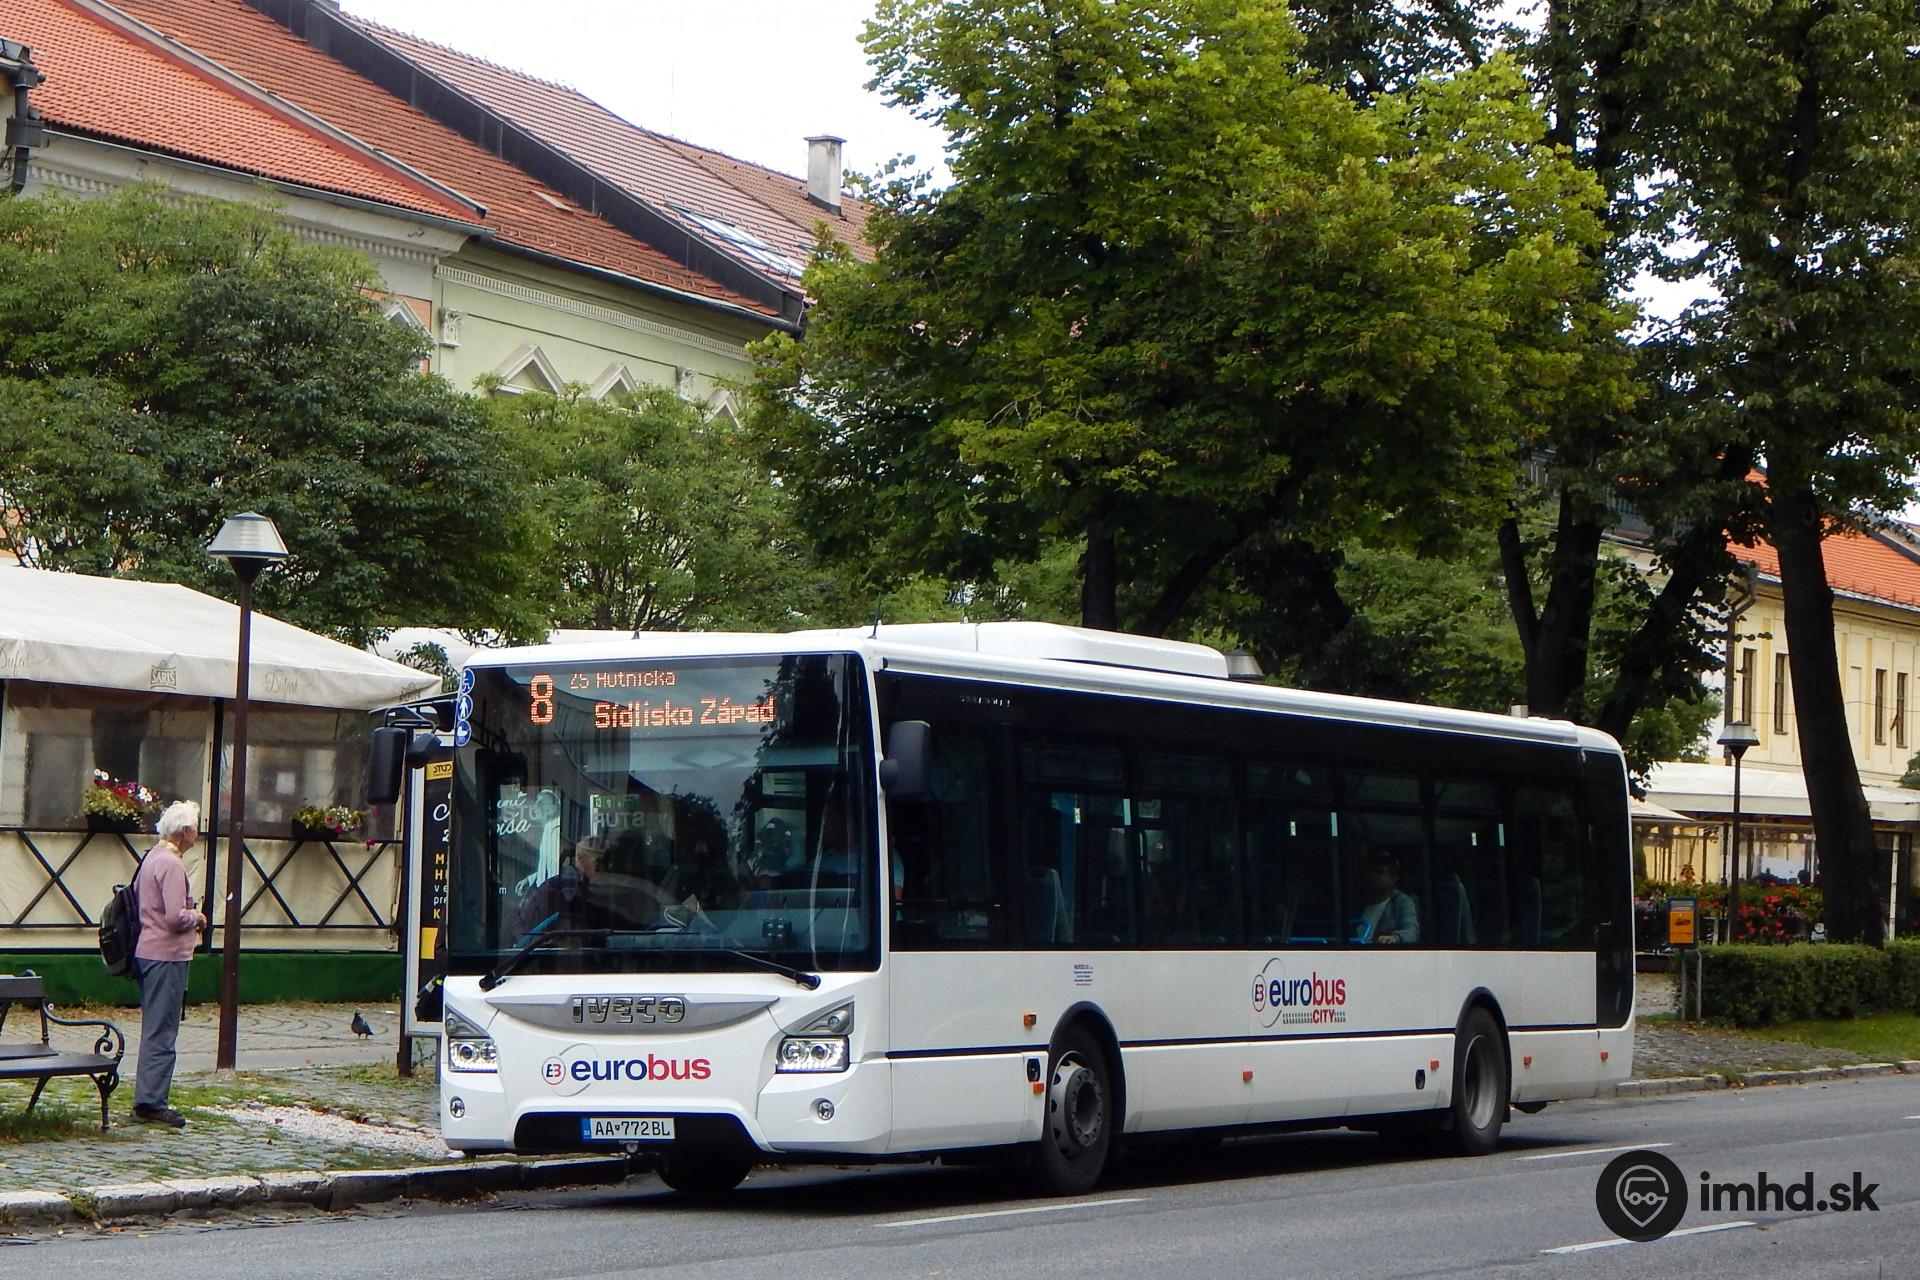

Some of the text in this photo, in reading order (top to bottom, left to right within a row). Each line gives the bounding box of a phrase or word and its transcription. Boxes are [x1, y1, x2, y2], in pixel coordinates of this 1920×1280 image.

[530, 674, 554, 723] 8
[595, 694, 776, 728] Sídlisko Západ
[1269, 971, 1346, 1007] eurobus
[572, 996, 686, 1024] IVECO
[1312, 1008, 1335, 1024] CITY
[570, 1053, 712, 1081] eurobus
